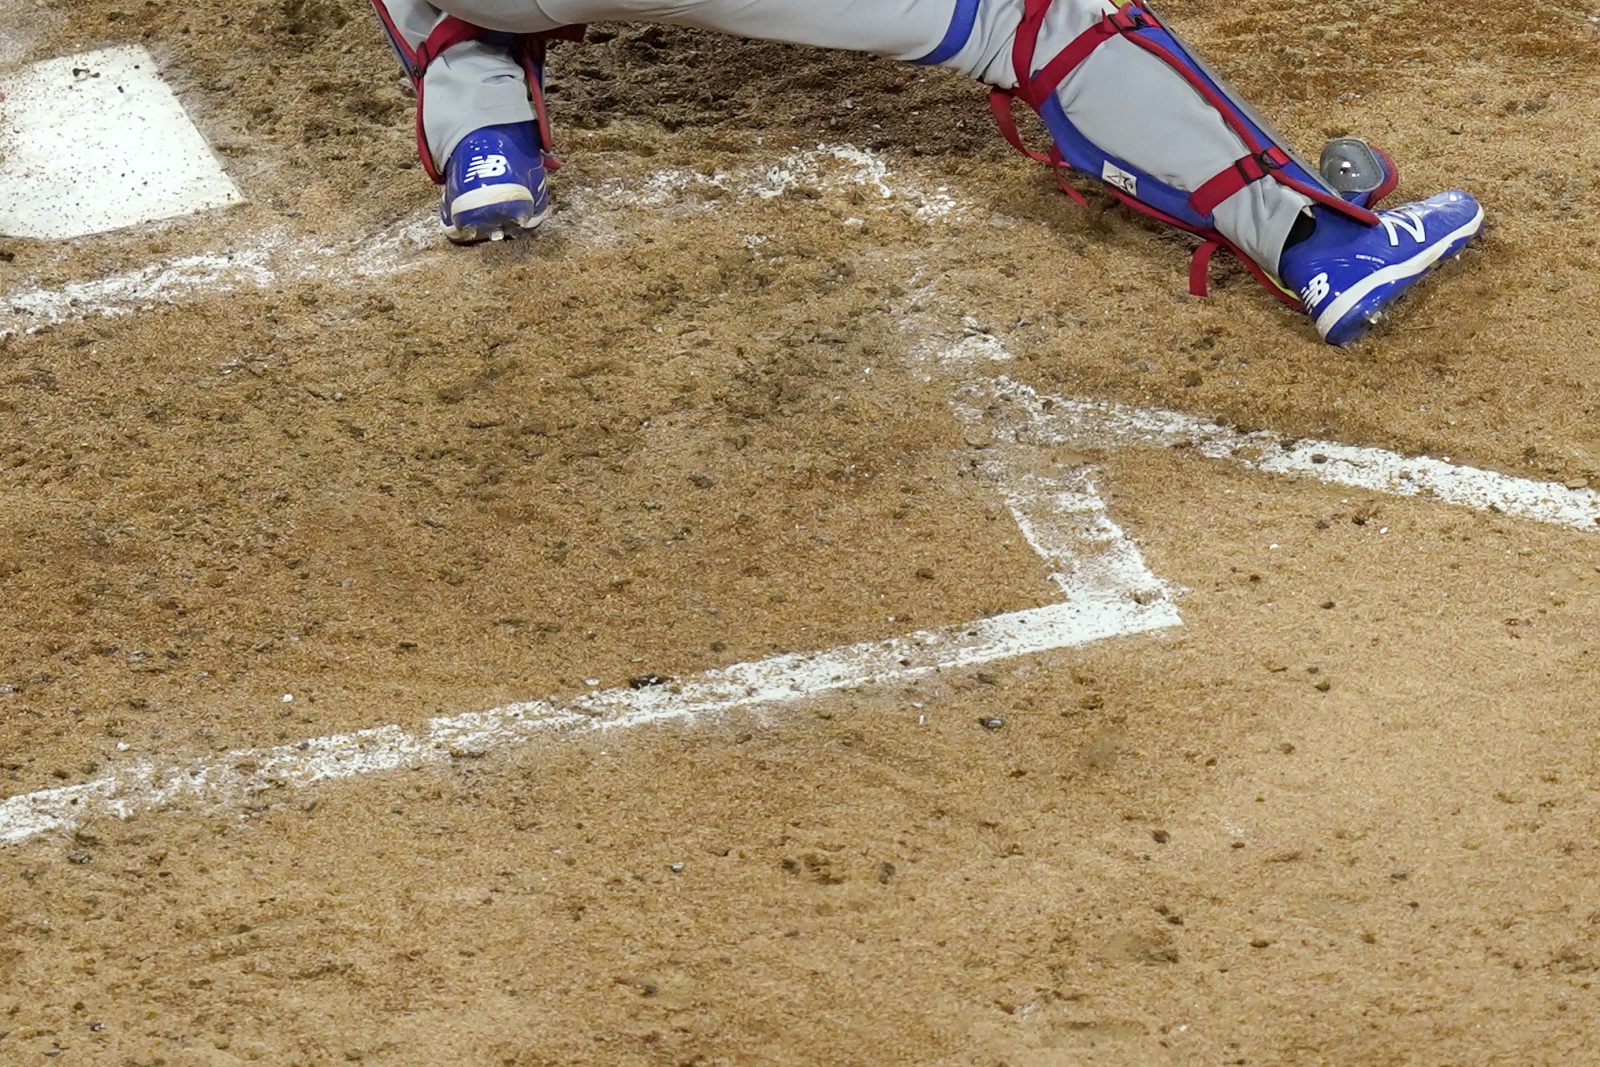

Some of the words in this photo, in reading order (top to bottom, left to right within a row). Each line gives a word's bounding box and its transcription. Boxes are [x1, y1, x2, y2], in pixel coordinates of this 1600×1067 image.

[463, 154, 508, 184] NB
[1379, 209, 1426, 246] N
[1300, 271, 1331, 316] NB
